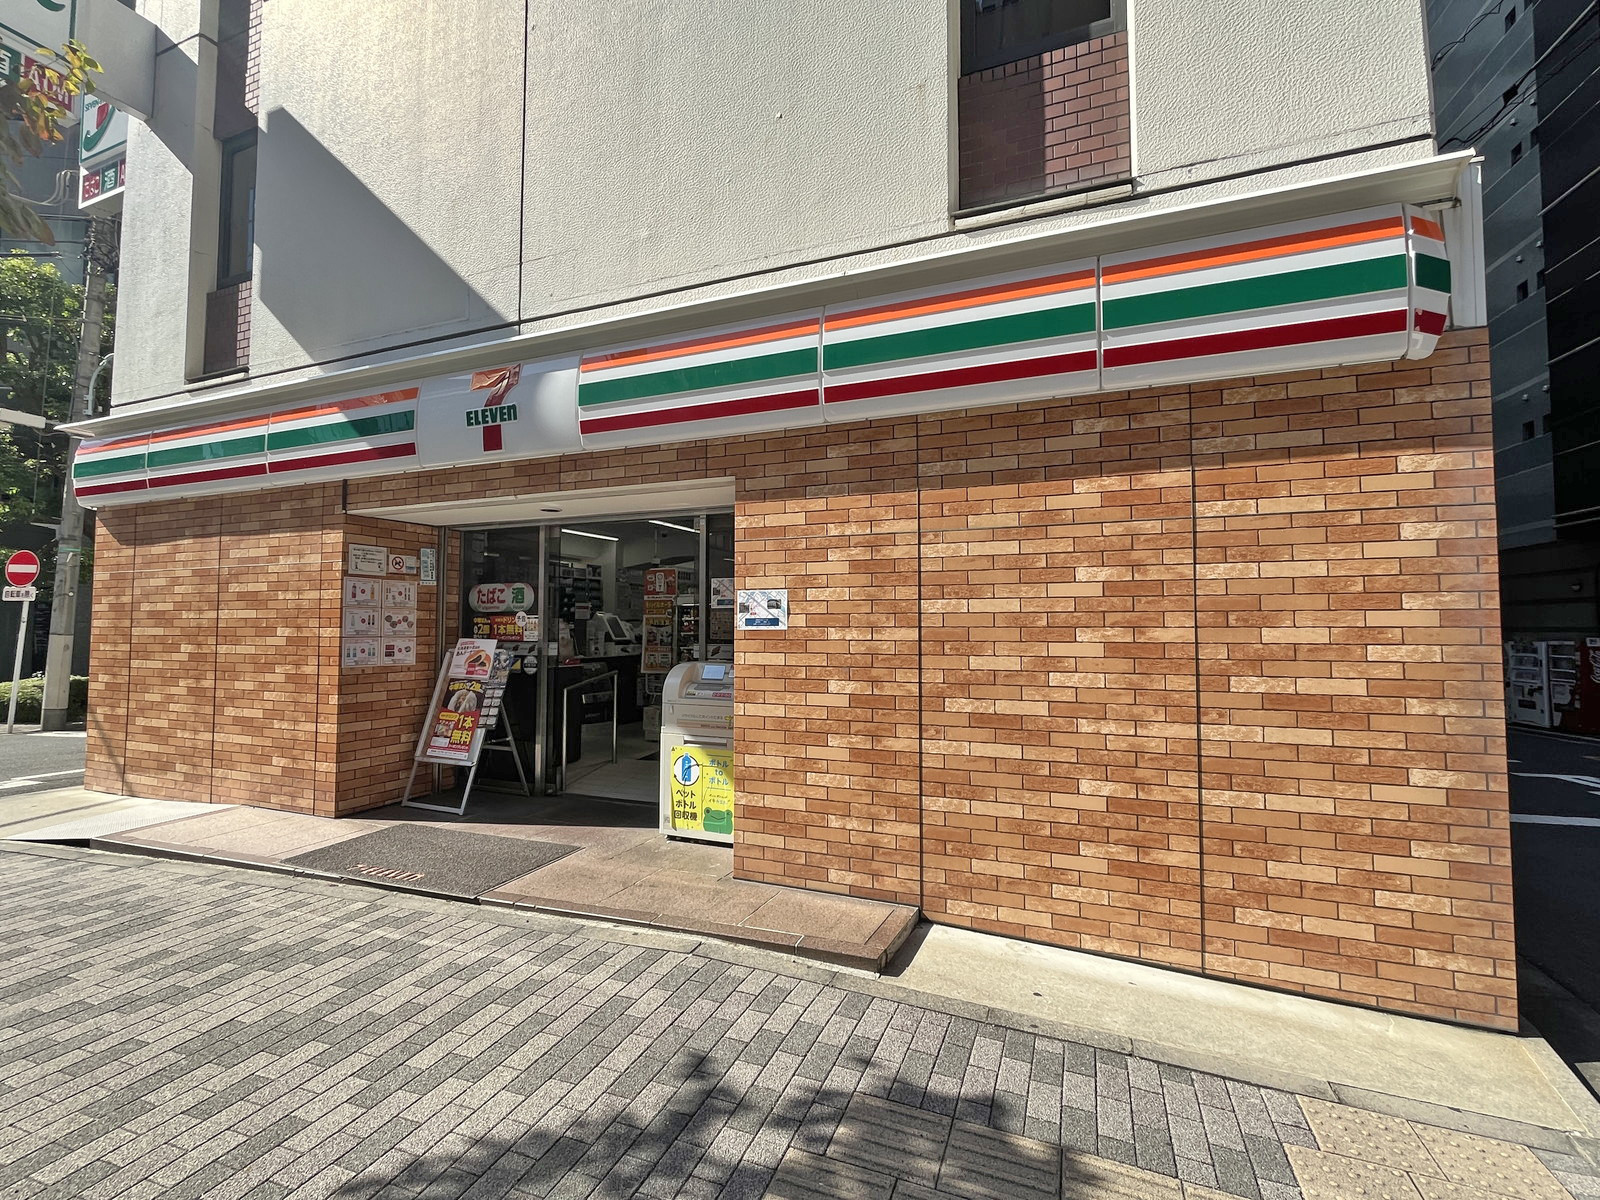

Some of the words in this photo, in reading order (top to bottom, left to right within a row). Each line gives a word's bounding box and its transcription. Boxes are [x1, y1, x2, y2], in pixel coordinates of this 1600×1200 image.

[476, 587, 506, 604] たばこ
[512, 587, 525, 604] 酒
[458, 714, 474, 729] 1本
[450, 729, 472, 745] 無料
[709, 759, 729, 769] ボトル
[709, 777, 729, 786] ボトル
[675, 789, 696, 798] ペット
[675, 799, 697, 810] ボトル
[674, 810, 698, 821] 回収機
